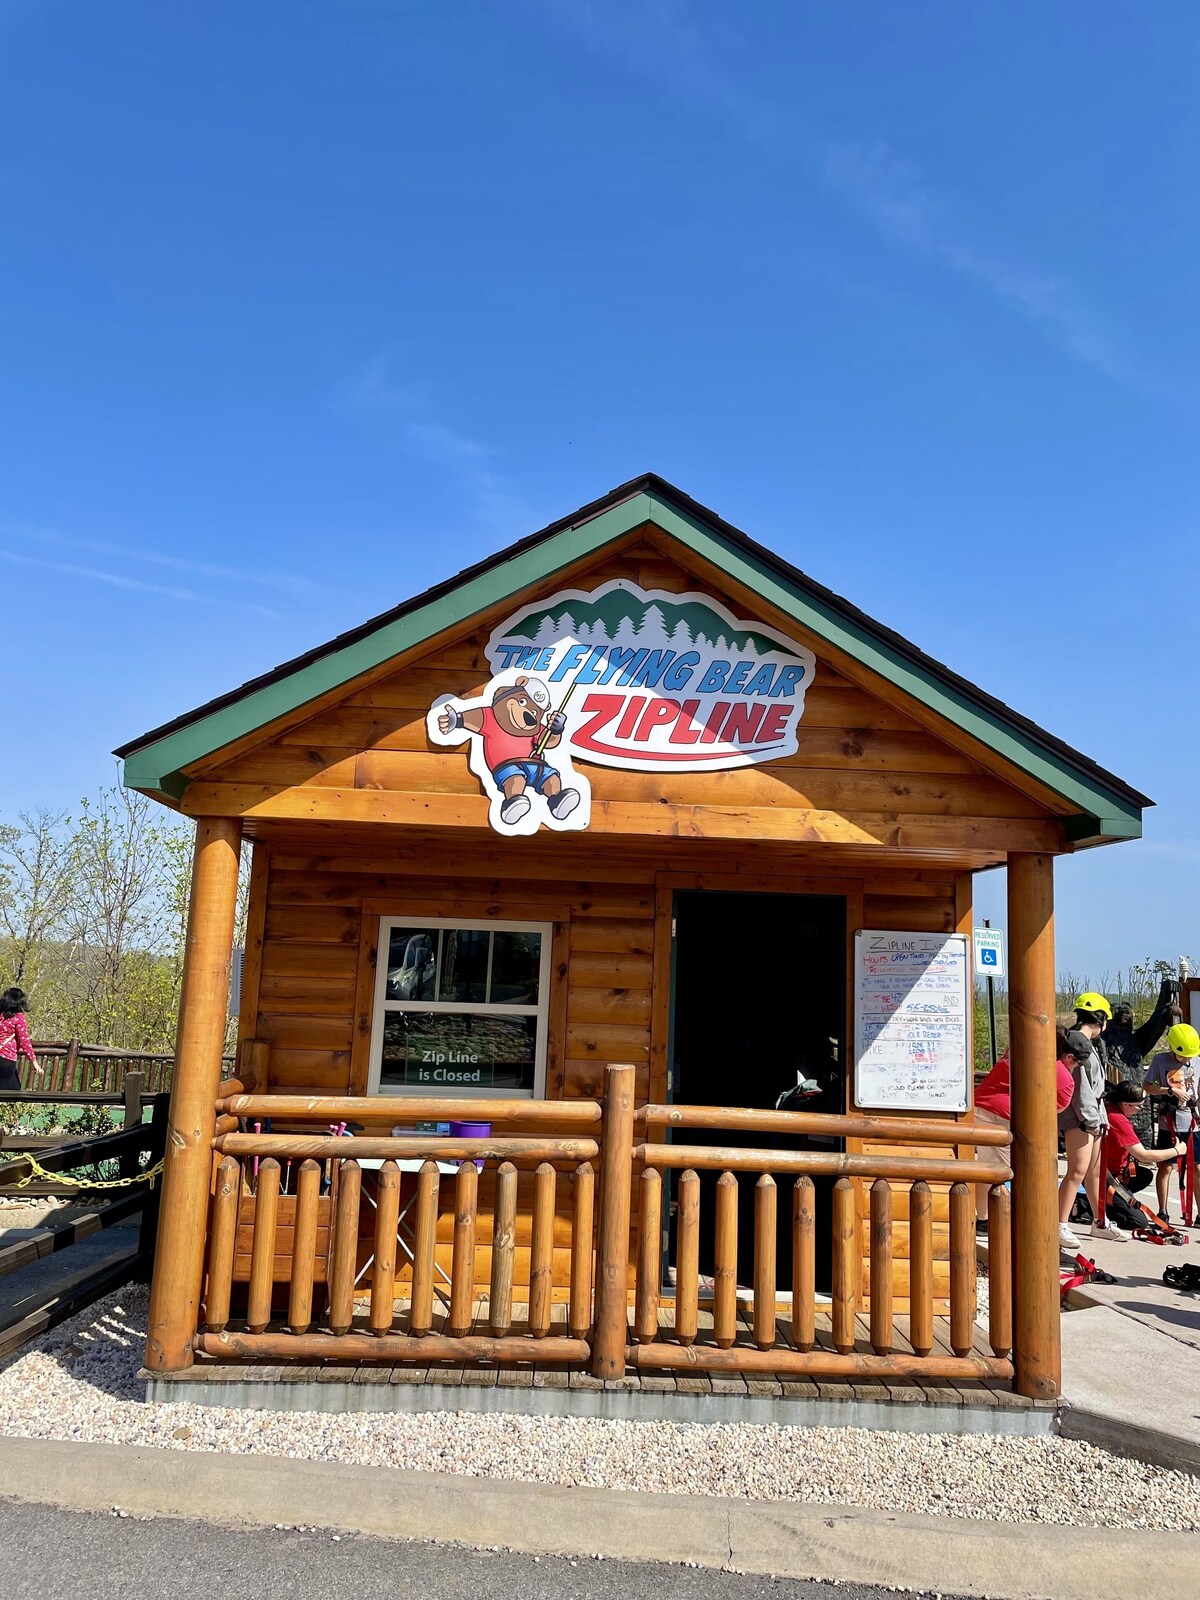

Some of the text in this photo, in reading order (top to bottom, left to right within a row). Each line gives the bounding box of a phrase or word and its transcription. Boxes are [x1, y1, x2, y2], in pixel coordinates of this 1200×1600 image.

[495, 644, 806, 697] THE FLYING BEAR
[570, 694, 794, 761] ZIPLINE
[975, 931, 1001, 940] RESERVED
[870, 937, 915, 950] ZIPLINE
[977, 940, 1000, 948] PARKING
[881, 995, 890, 1003] BE
[943, 995, 959, 1005] AND
[422, 1050, 478, 1065] Zip Line
[419, 1069, 481, 1082] is Closed
